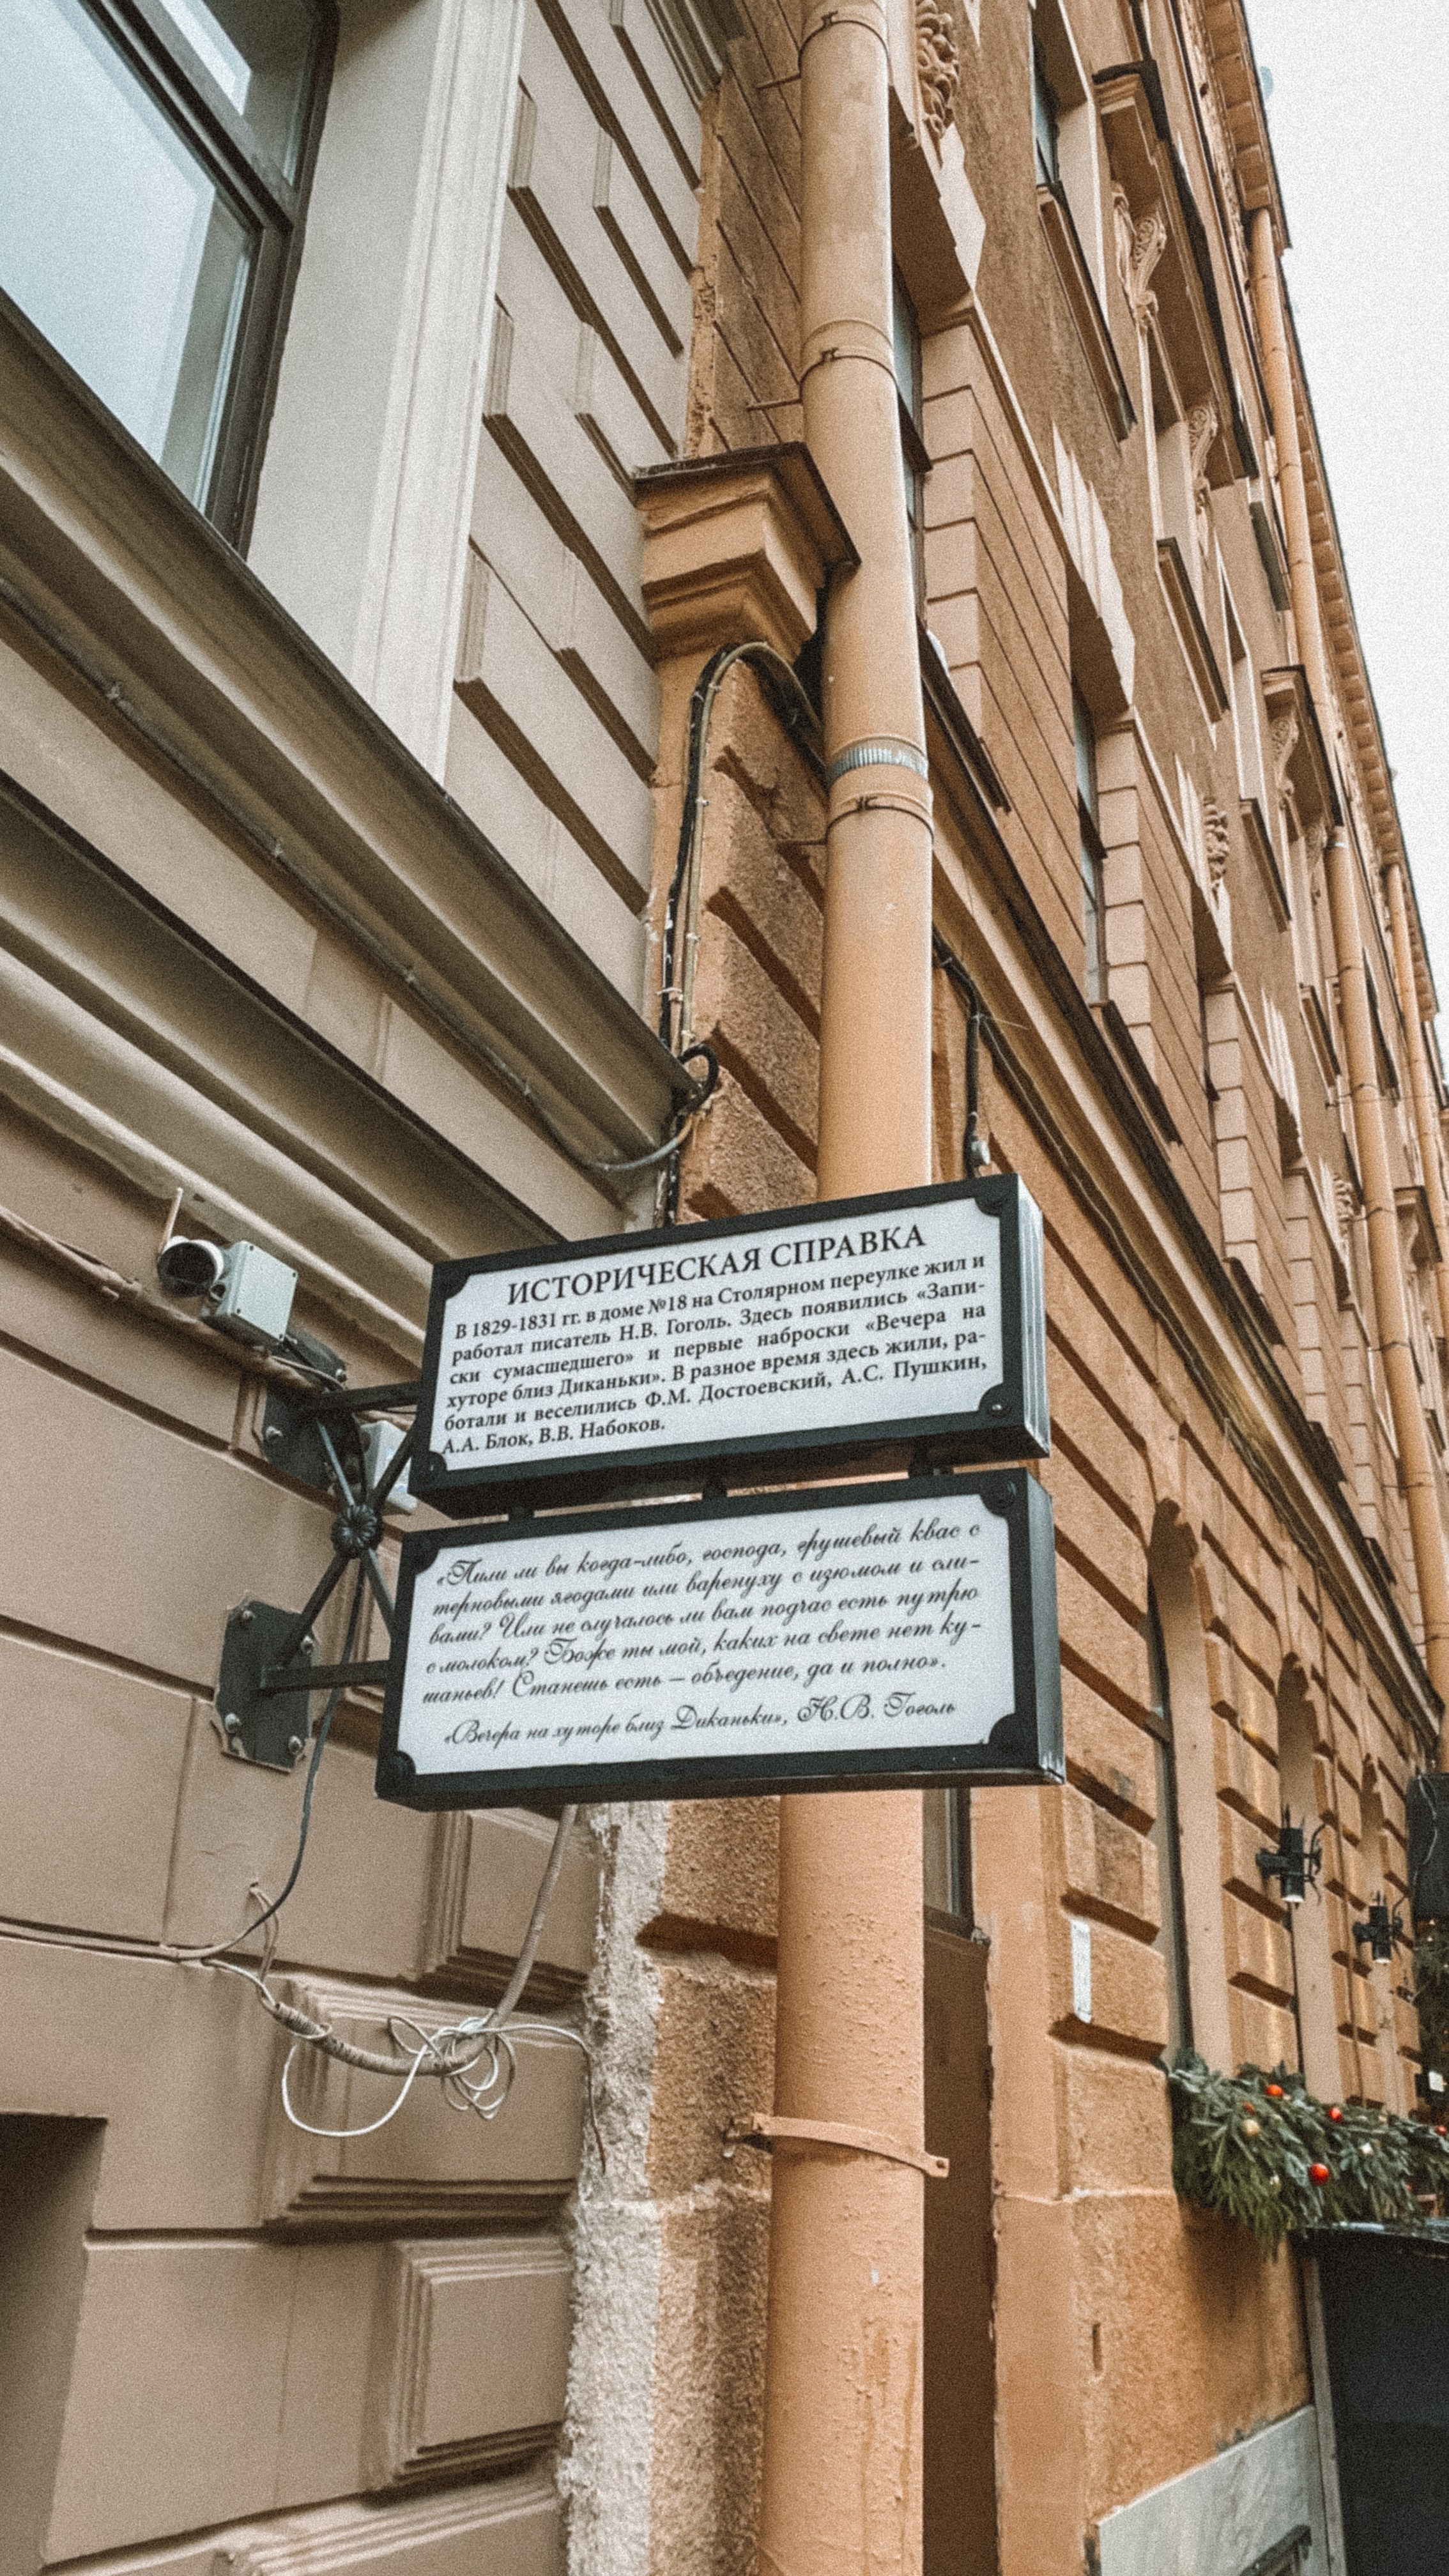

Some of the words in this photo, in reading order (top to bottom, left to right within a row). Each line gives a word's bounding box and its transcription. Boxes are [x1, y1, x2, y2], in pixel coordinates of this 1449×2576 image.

[454, 1322, 468, 1340] В
[472, 1312, 556, 1338] 1829-1831
[561, 1312, 581, 1326] гг.
[585, 1310, 596, 1324] в
[598, 1303, 645, 1324] доме
[647, 1293, 688, 1315] №18
[691, 1294, 714, 1308] на
[716, 1278, 825, 1305] Столярном
[829, 1264, 919, 1292] переулке
[923, 1257, 967, 1276] жил
[971, 1255, 985, 1269] и
[508, 1248, 760, 1305] ИСТОРИЧЕСКАЯ
[770, 1224, 925, 1267] СПРАВКА
[448, 1369, 481, 1385] ски
[492, 1352, 634, 1384] сумасшедшего»
[647, 1347, 660, 1361] и
[673, 1337, 744, 1361] первые
[756, 1322, 850, 1348] наброски
[864, 1310, 947, 1332] «Вечера
[962, 1304, 986, 1321] на
[450, 1342, 524, 1367] работал
[530, 1331, 611, 1353] писатель
[618, 1321, 658, 1342] Н.В.
[666, 1315, 732, 1336] Гоголь.
[739, 1307, 793, 1326] Здесь
[800, 1291, 908, 1317] появились
[916, 1280, 985, 1300] «Запи-
[443, 1413, 507, 1432] ботали
[513, 1410, 527, 1424] и
[533, 1397, 638, 1422] веселились
[644, 1386, 691, 1408] Ф.М.
[697, 1370, 832, 1406] Достоевский,
[840, 1363, 884, 1385] А.С.
[893, 1355, 987, 1382] Пушкин,
[445, 1389, 509, 1413] хуторе
[511, 1383, 554, 1400] близ
[556, 1372, 666, 1399] Диканьки».
[671, 1363, 686, 1382] В
[688, 1359, 756, 1384] разное
[760, 1351, 821, 1375] время
[825, 1344, 880, 1364] здесь
[884, 1335, 948, 1356] жили,
[953, 1330, 986, 1352] ра-
[441, 1436, 480, 1454] А.А.
[484, 1432, 533, 1450] Блок,
[537, 1424, 574, 1445] В.В.
[578, 1418, 666, 1439] Набоков.
[435, 1556, 508, 1586] «Пили
[512, 1565, 539, 1580] ли
[544, 1553, 570, 1577] вы
[575, 1540, 693, 1582] когда-либо,
[701, 1542, 787, 1568] господа,
[796, 1522, 902, 1562] грушевый
[908, 1515, 961, 1542] квас
[968, 1523, 980, 1537] с
[427, 1620, 493, 1645] вами?
[498, 1610, 546, 1639] Или
[551, 1620, 576, 1635] не
[579, 1613, 675, 1642] случалось
[678, 1609, 705, 1625] ли
[710, 1597, 755, 1622] вам
[760, 1598, 832, 1627] подчас
[836, 1595, 889, 1611] есть
[431, 1586, 545, 1623] терновыми
[549, 1586, 636, 1613] ягодами
[641, 1582, 679, 1597] или
[684, 1566, 783, 1601] варенуху
[790, 1570, 803, 1584] с
[808, 1561, 901, 1593] изюмом
[908, 1560, 924, 1574] и
[930, 1556, 979, 1572] сли-
[425, 1661, 437, 1674] с
[438, 1645, 540, 1674] молоком?
[542, 1636, 616, 1671] Боже
[620, 1644, 655, 1660] ты
[658, 1636, 707, 1657] мой,
[712, 1625, 779, 1652] каких
[783, 1632, 811, 1647] на
[816, 1618, 880, 1644] свете
[886, 1623, 934, 1639] нет
[938, 1609, 981, 1646] ку-
[421, 1676, 506, 1704] шаньев!
[510, 1667, 609, 1698] Станешь
[613, 1675, 663, 1690] есть
[690, 1659, 799, 1694] объедение,
[802, 1662, 834, 1689] да
[839, 1660, 855, 1675] и
[861, 1655, 946, 1673] полно».
[443, 1718, 521, 1750] «Вечера
[525, 1727, 549, 1740] на
[551, 1712, 621, 1747] хуторе
[624, 1711, 665, 1742] близ
[669, 1703, 788, 1731] Диканьки»,
[883, 1690, 956, 1719] Гоголь
